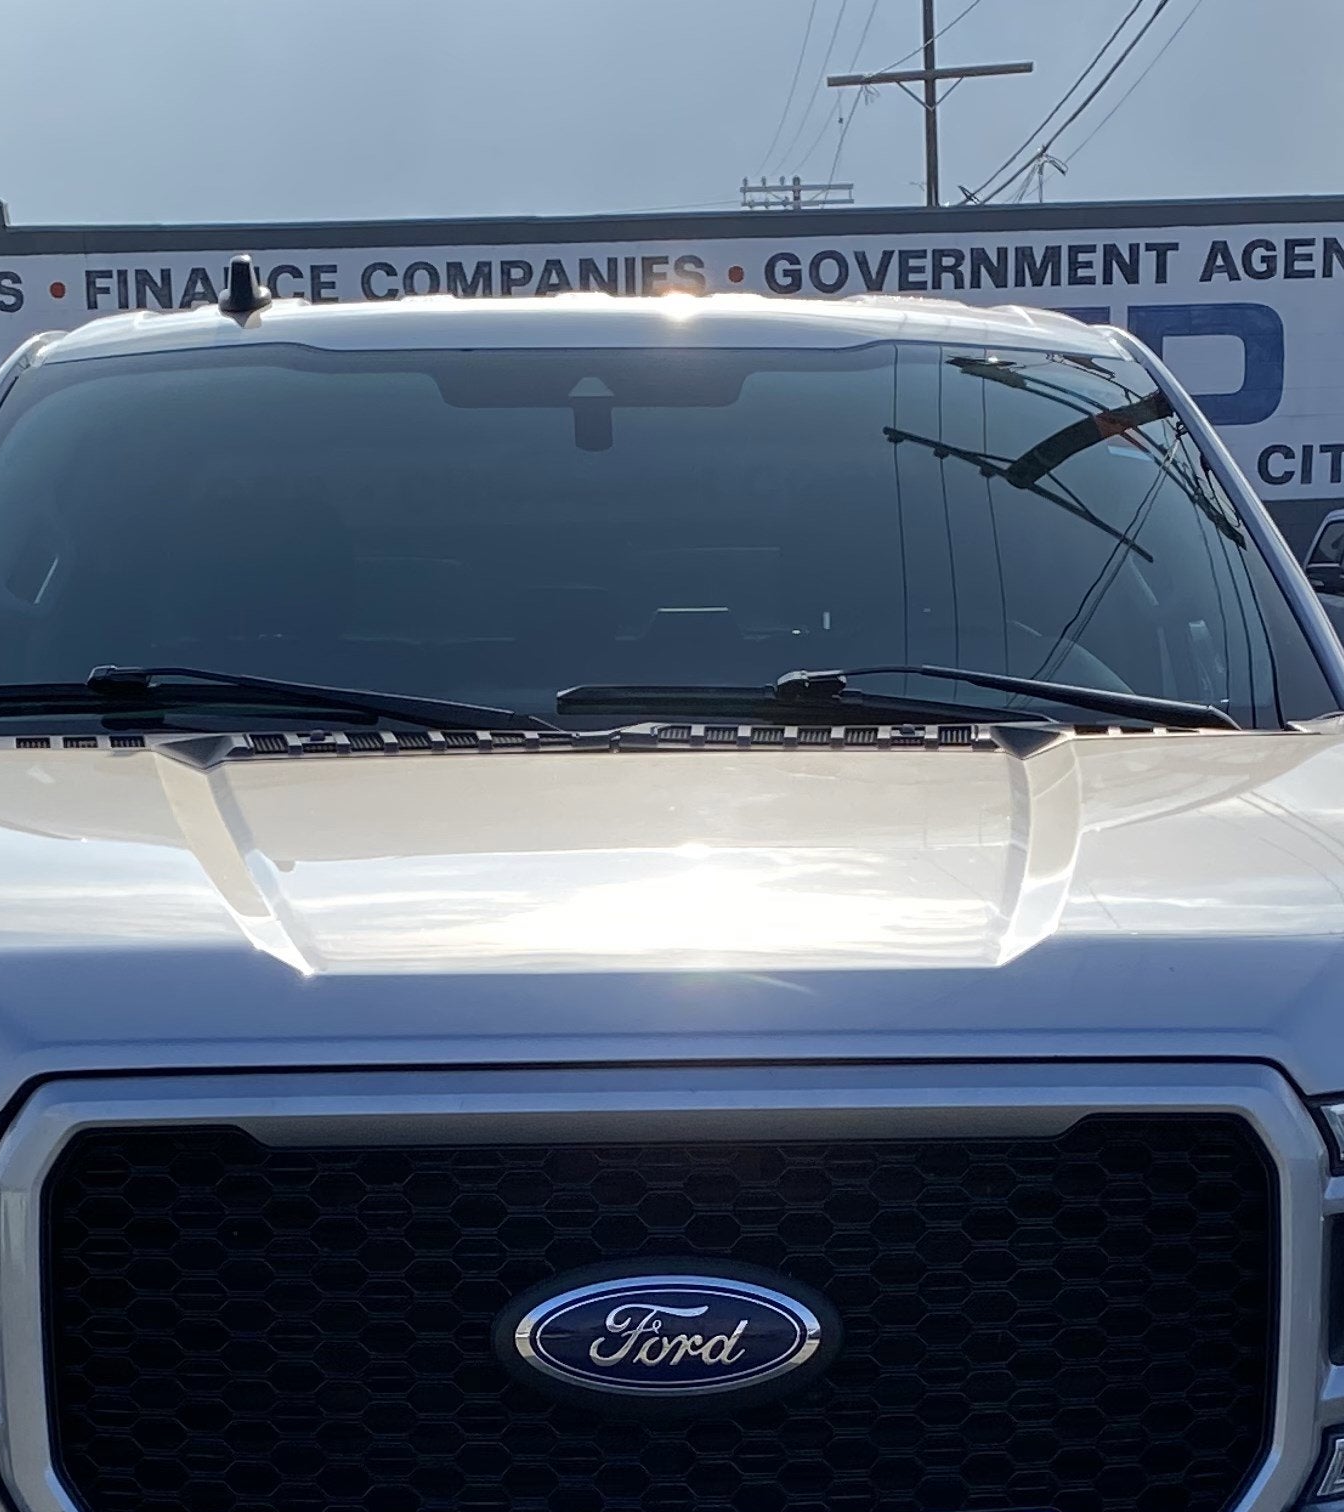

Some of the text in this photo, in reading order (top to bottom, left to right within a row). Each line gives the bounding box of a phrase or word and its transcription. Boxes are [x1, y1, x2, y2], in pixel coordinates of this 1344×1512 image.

[84, 254, 708, 310] FINACE COMPANIES
[764, 241, 1179, 294] GOVERNMENT
[588, 1302, 750, 1367] Ford
